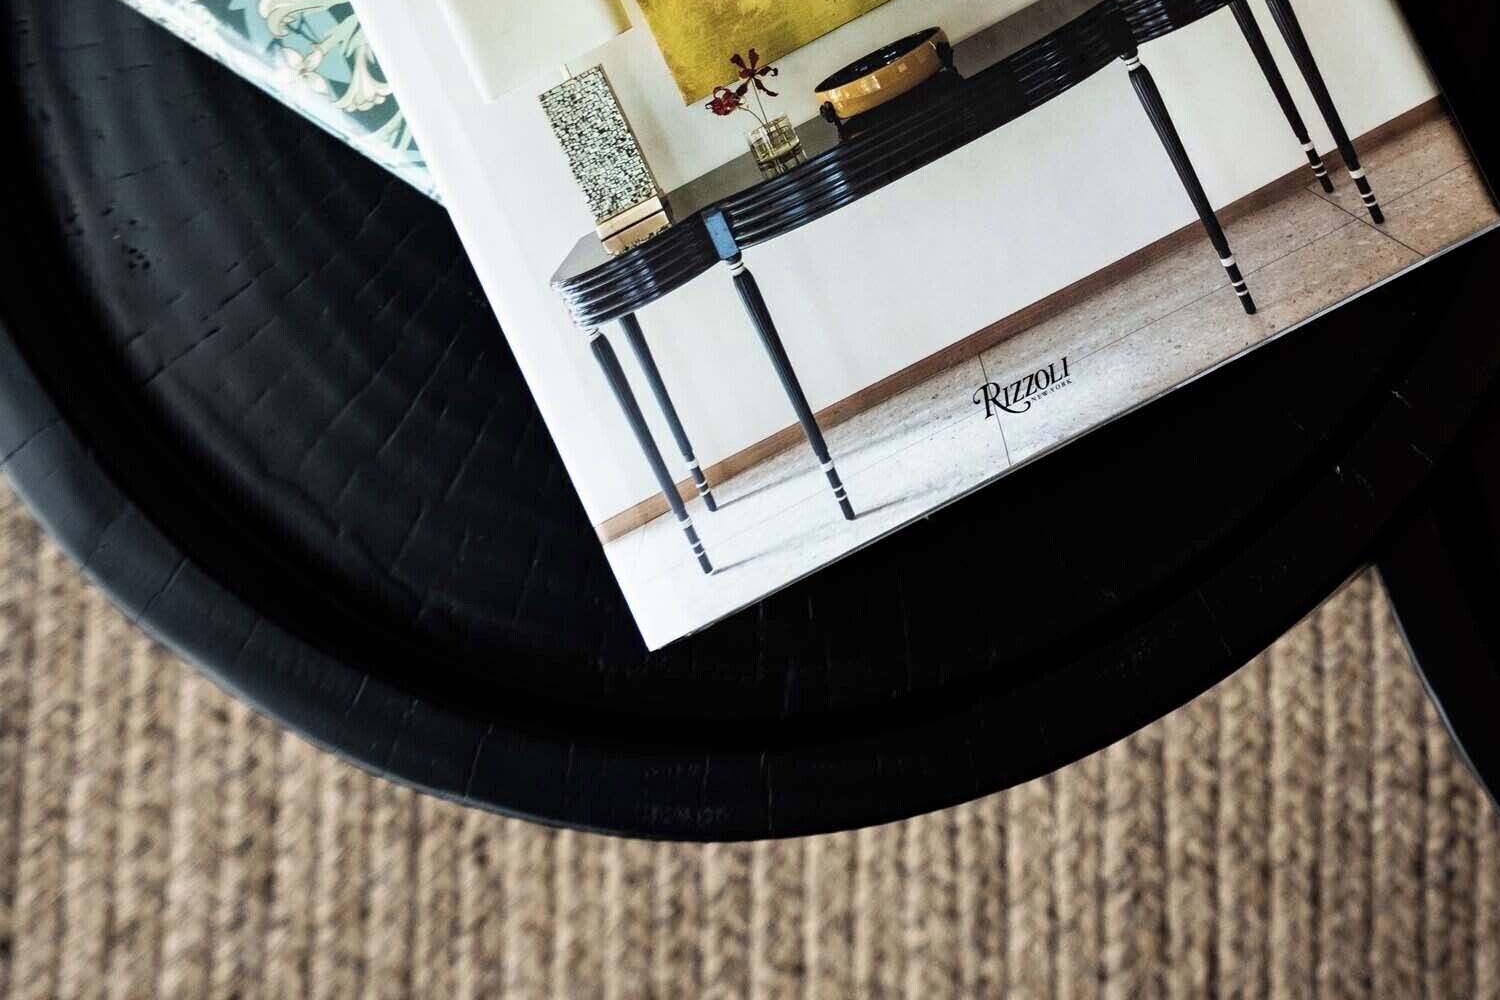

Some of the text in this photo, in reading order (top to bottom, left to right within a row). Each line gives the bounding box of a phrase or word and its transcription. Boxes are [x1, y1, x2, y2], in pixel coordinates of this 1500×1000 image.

[972, 356, 1070, 419] RIZZOLI
[1031, 378, 1072, 401] NEW YORK
